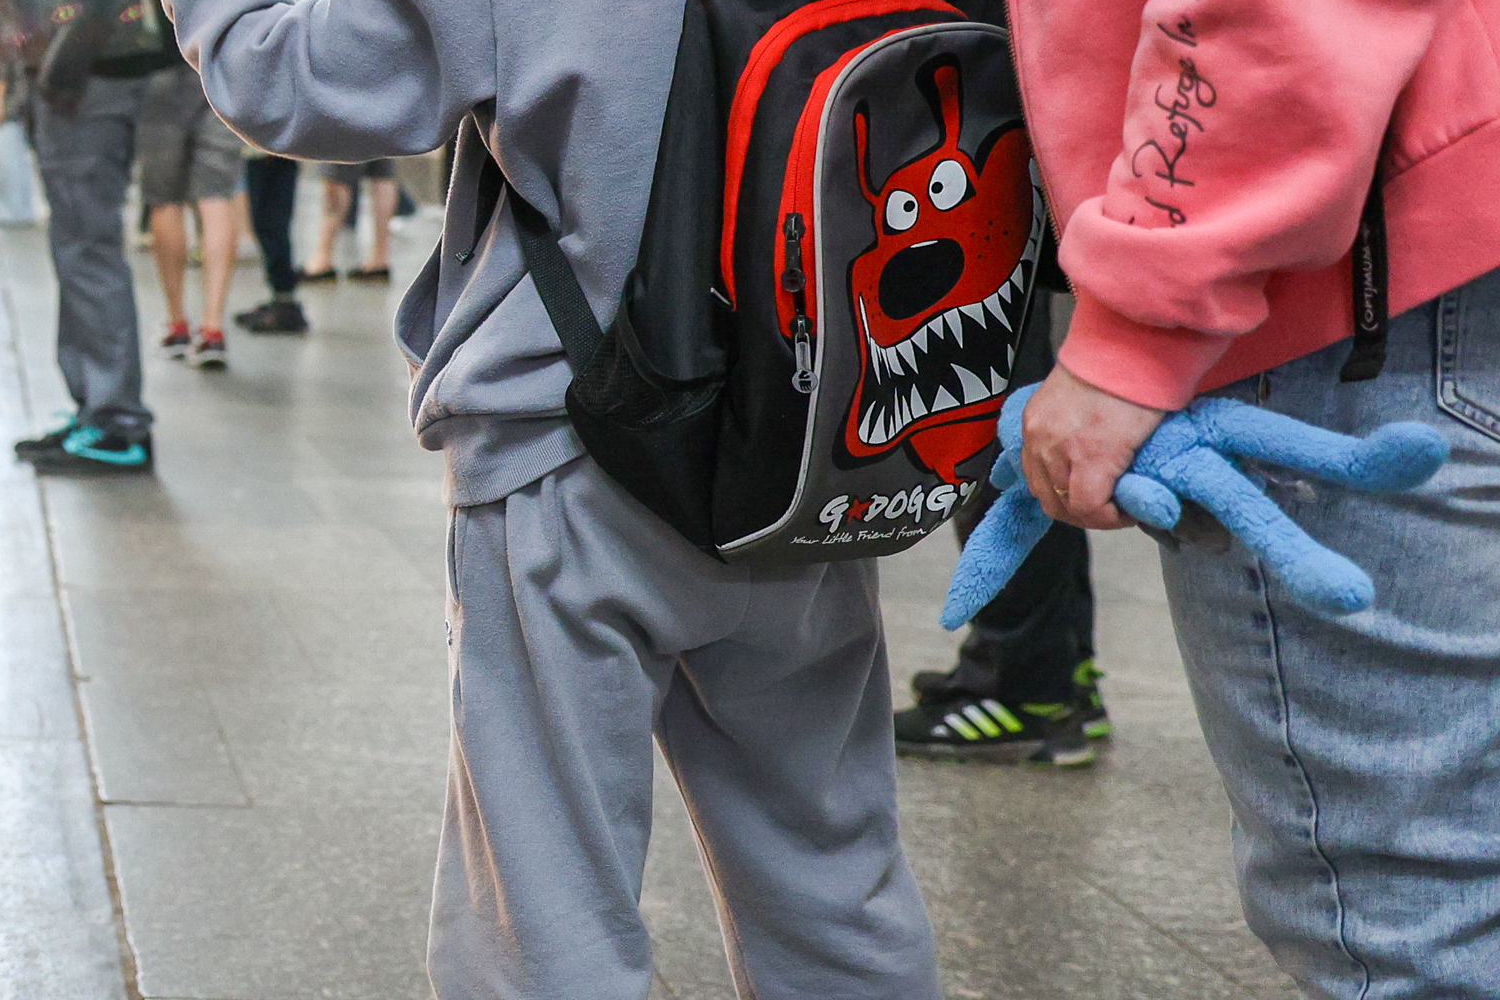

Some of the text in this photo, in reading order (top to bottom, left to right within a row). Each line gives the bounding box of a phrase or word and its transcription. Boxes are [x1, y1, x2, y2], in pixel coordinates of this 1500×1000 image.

[1132, 57, 1217, 188] Refuge
[821, 530, 853, 545] Little
[857, 528, 895, 542] Friend
[895, 526, 927, 541] from
